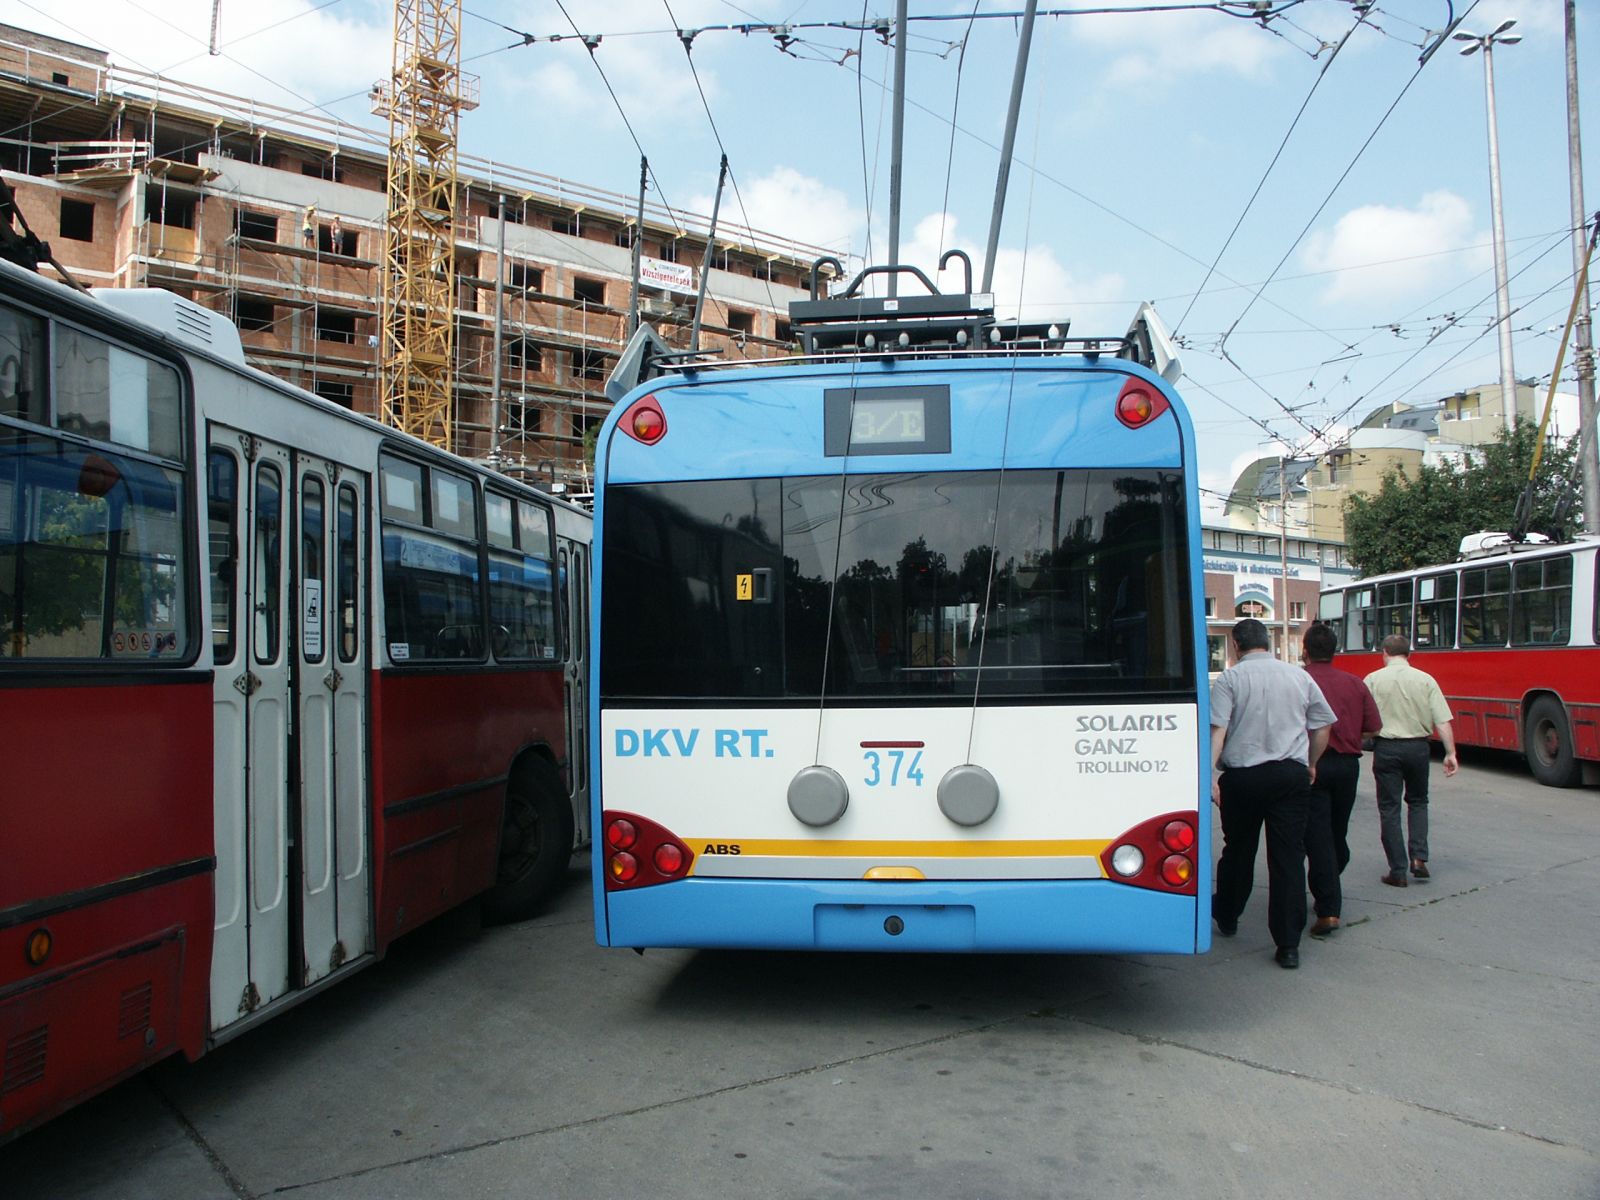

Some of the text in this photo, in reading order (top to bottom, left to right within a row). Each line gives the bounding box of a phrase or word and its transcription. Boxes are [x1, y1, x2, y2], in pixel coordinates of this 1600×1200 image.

[1075, 714, 1178, 732] SOLARIS
[615, 729, 774, 758] DKV RT.
[1074, 738, 1138, 755] GANZ
[863, 750, 924, 786] 374
[703, 844, 741, 855] ABS
